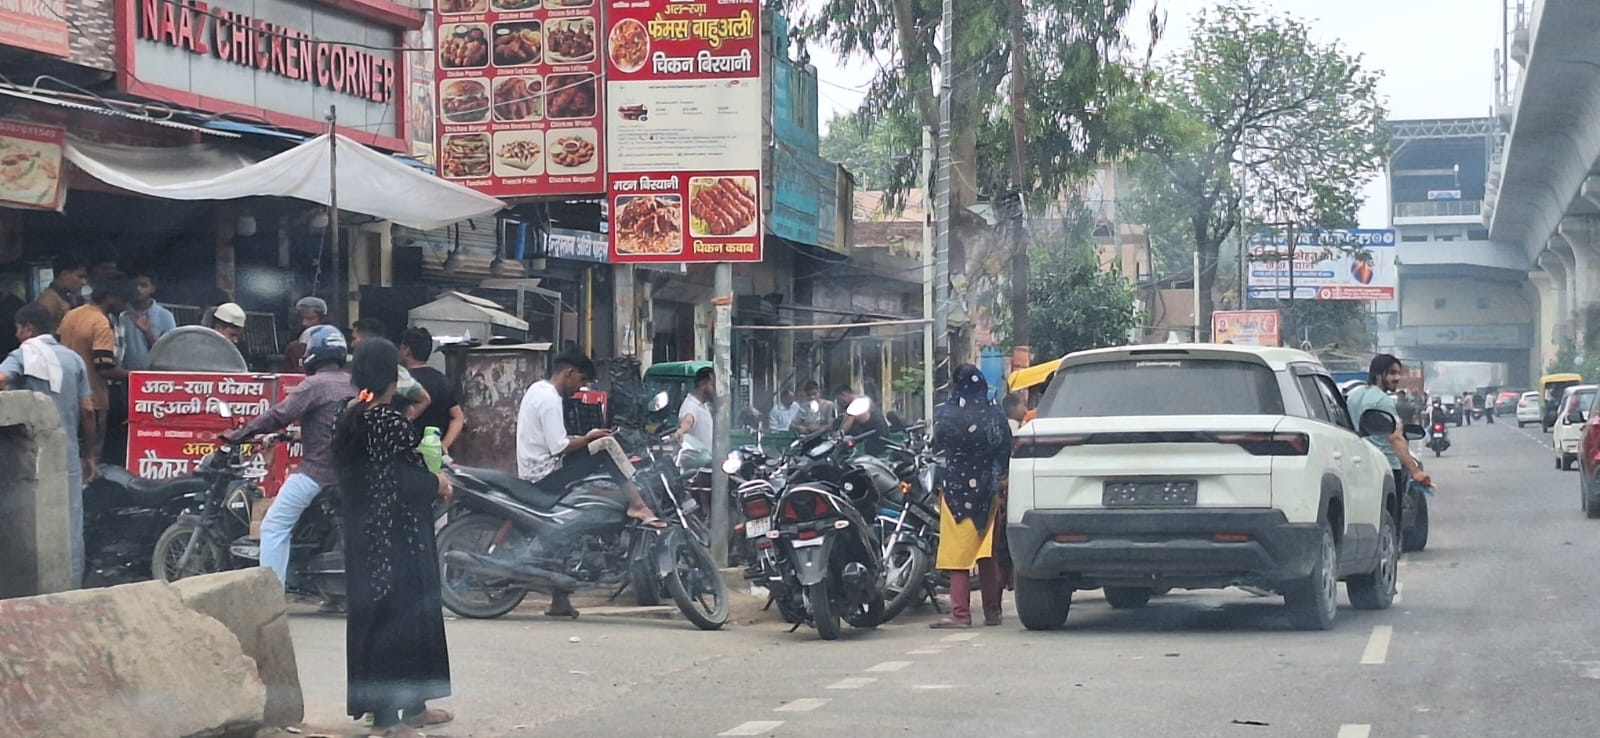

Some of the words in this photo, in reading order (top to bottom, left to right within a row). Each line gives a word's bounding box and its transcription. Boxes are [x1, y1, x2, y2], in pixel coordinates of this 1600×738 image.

[143, 0, 209, 54] NAAZ
[215, 7, 312, 82] CHICKEN
[316, 39, 394, 103] CORNER
[652, 51, 694, 73] चिकन
